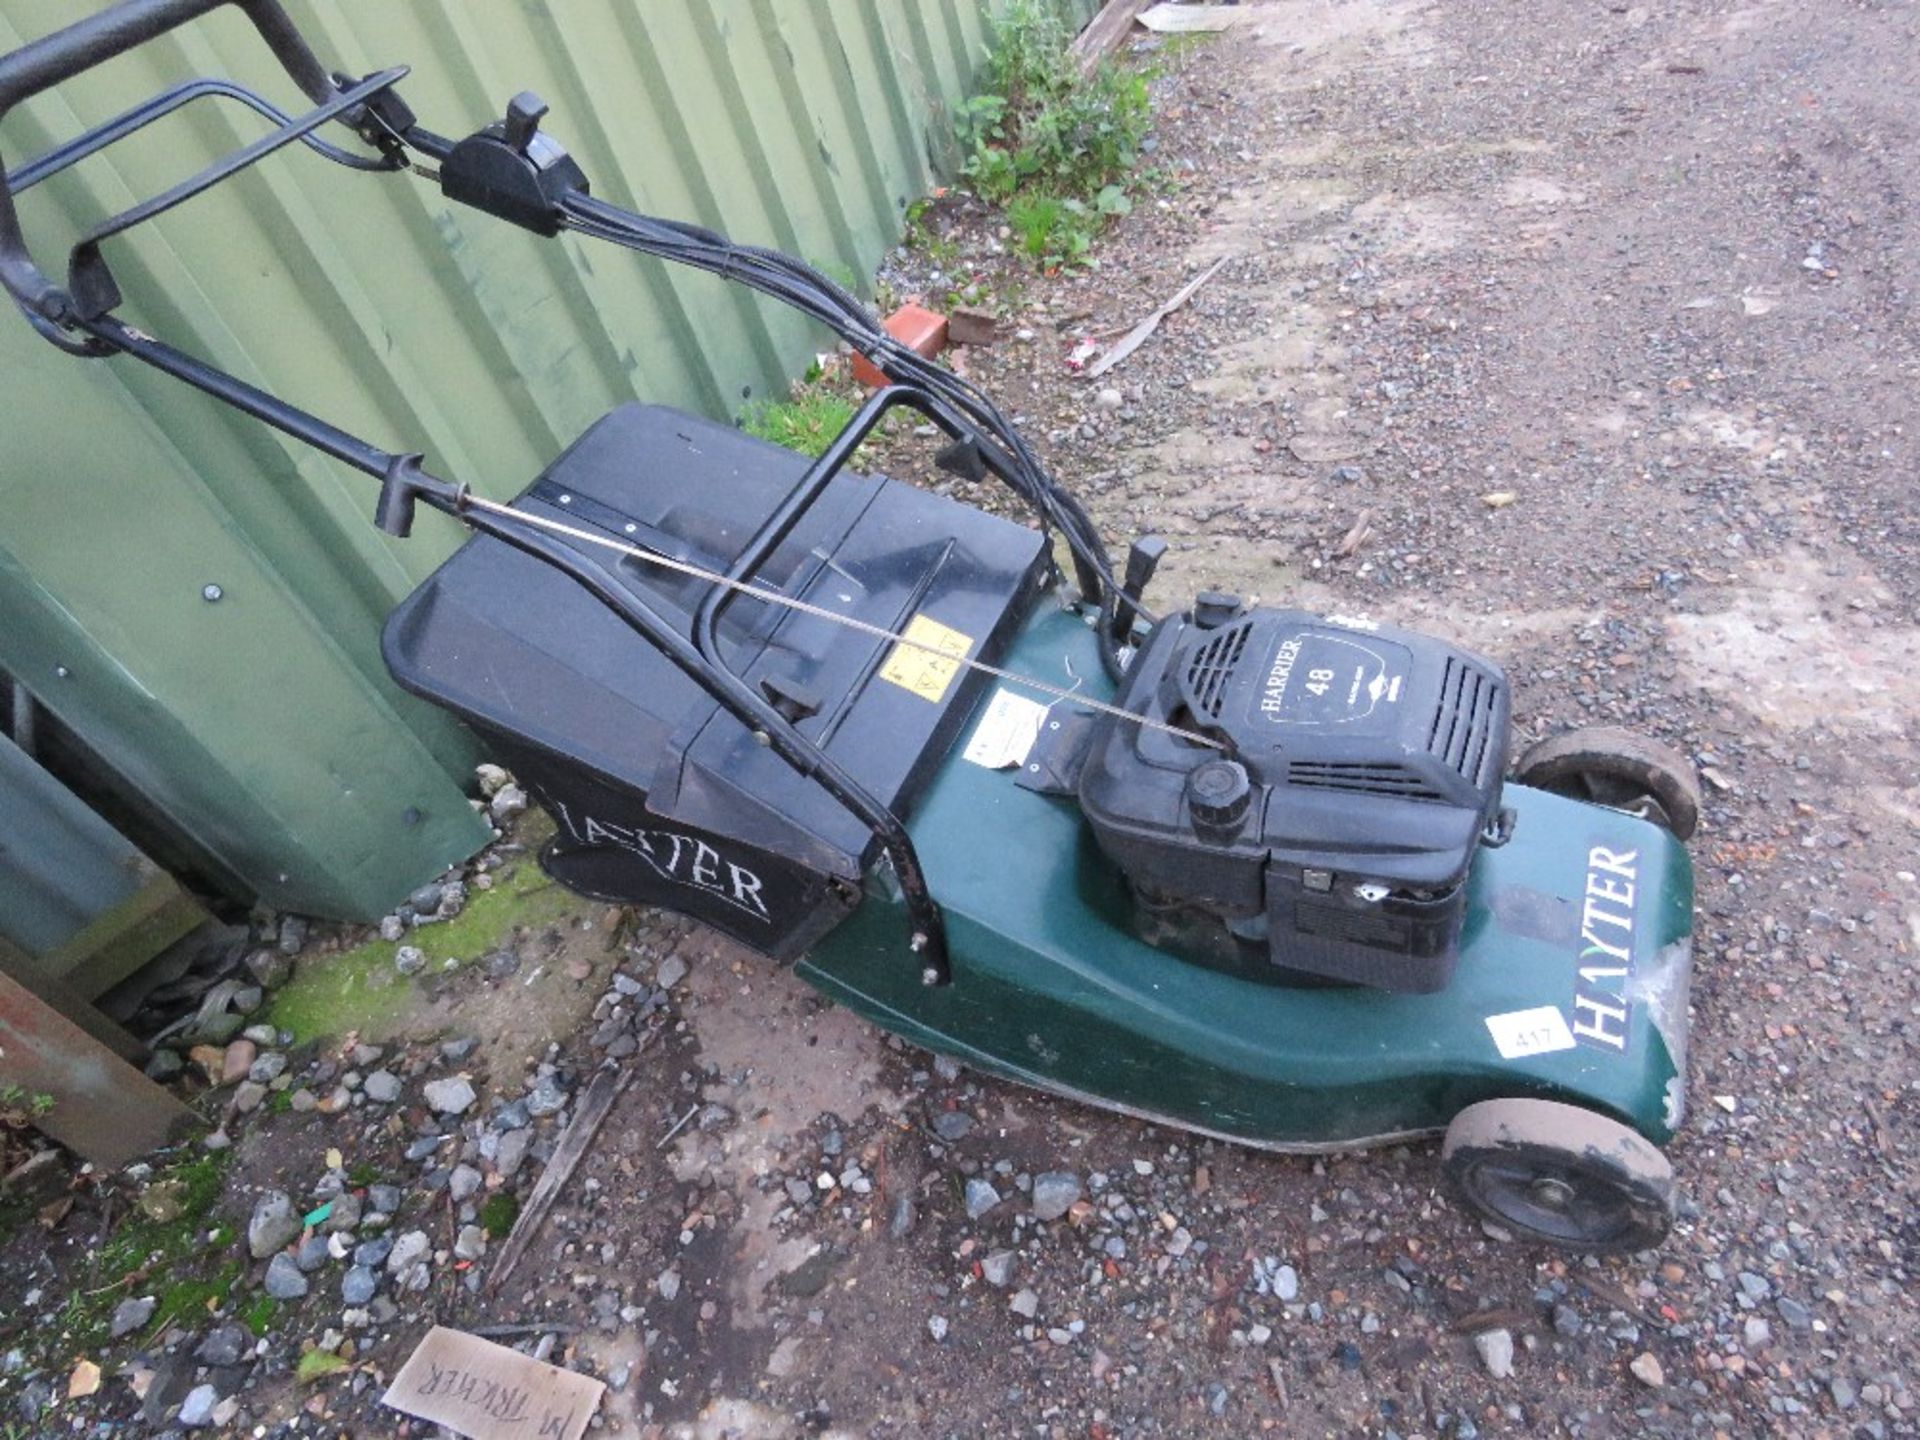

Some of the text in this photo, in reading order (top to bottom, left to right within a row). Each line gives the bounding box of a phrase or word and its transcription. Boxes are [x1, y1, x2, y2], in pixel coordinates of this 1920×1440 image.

[1261, 640, 1303, 713] HARRIER
[1304, 668, 1335, 697] 48
[1572, 845, 1638, 1051] HAYTER
[1515, 1026, 1552, 1050] 417
